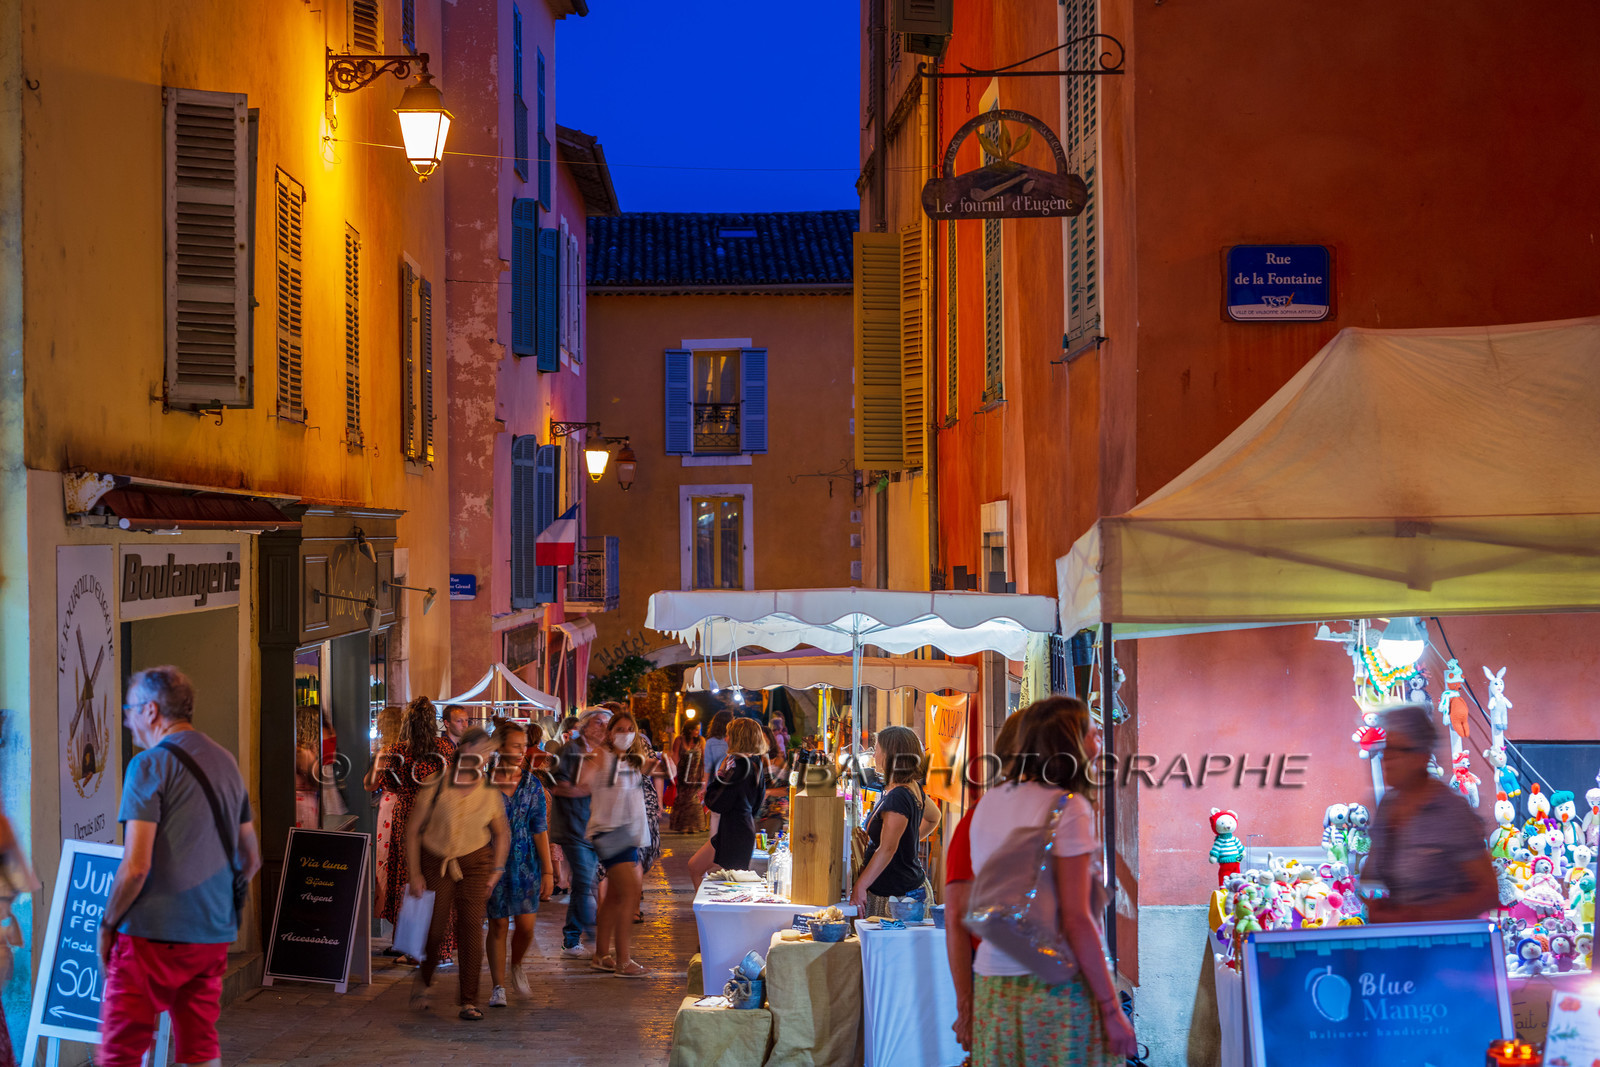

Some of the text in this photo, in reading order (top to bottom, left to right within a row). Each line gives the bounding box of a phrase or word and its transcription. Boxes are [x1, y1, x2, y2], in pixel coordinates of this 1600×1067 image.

[936, 195, 1073, 216] Le fournil d'Eugène
[1266, 252, 1291, 265] Rue
[1234, 272, 1322, 285] de la Fontaine
[121, 551, 240, 607] Boulangerie
[300, 856, 349, 871] Via luna
[300, 892, 333, 903] Argent
[61, 936, 95, 953] Mode
[281, 932, 340, 945] Accessoires
[1358, 972, 1416, 996] Blue
[1362, 998, 1448, 1024] Mango
